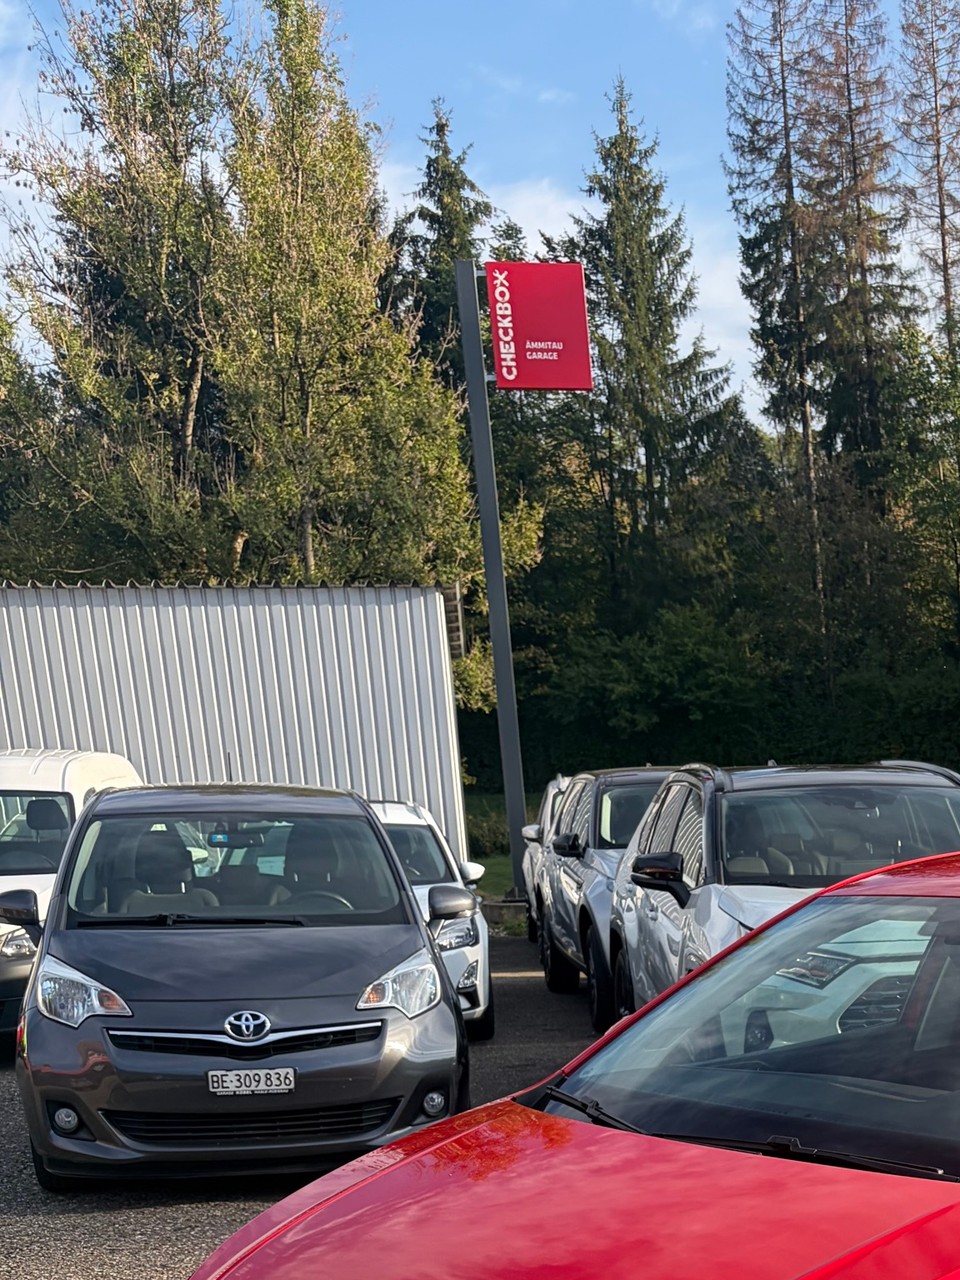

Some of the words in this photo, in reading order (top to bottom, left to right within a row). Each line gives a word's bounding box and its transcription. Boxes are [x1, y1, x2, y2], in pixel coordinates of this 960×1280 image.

[492, 269, 518, 381] CHECKBOX
[526, 352, 559, 360] GARAGE
[265, 1072, 292, 1087] 836
